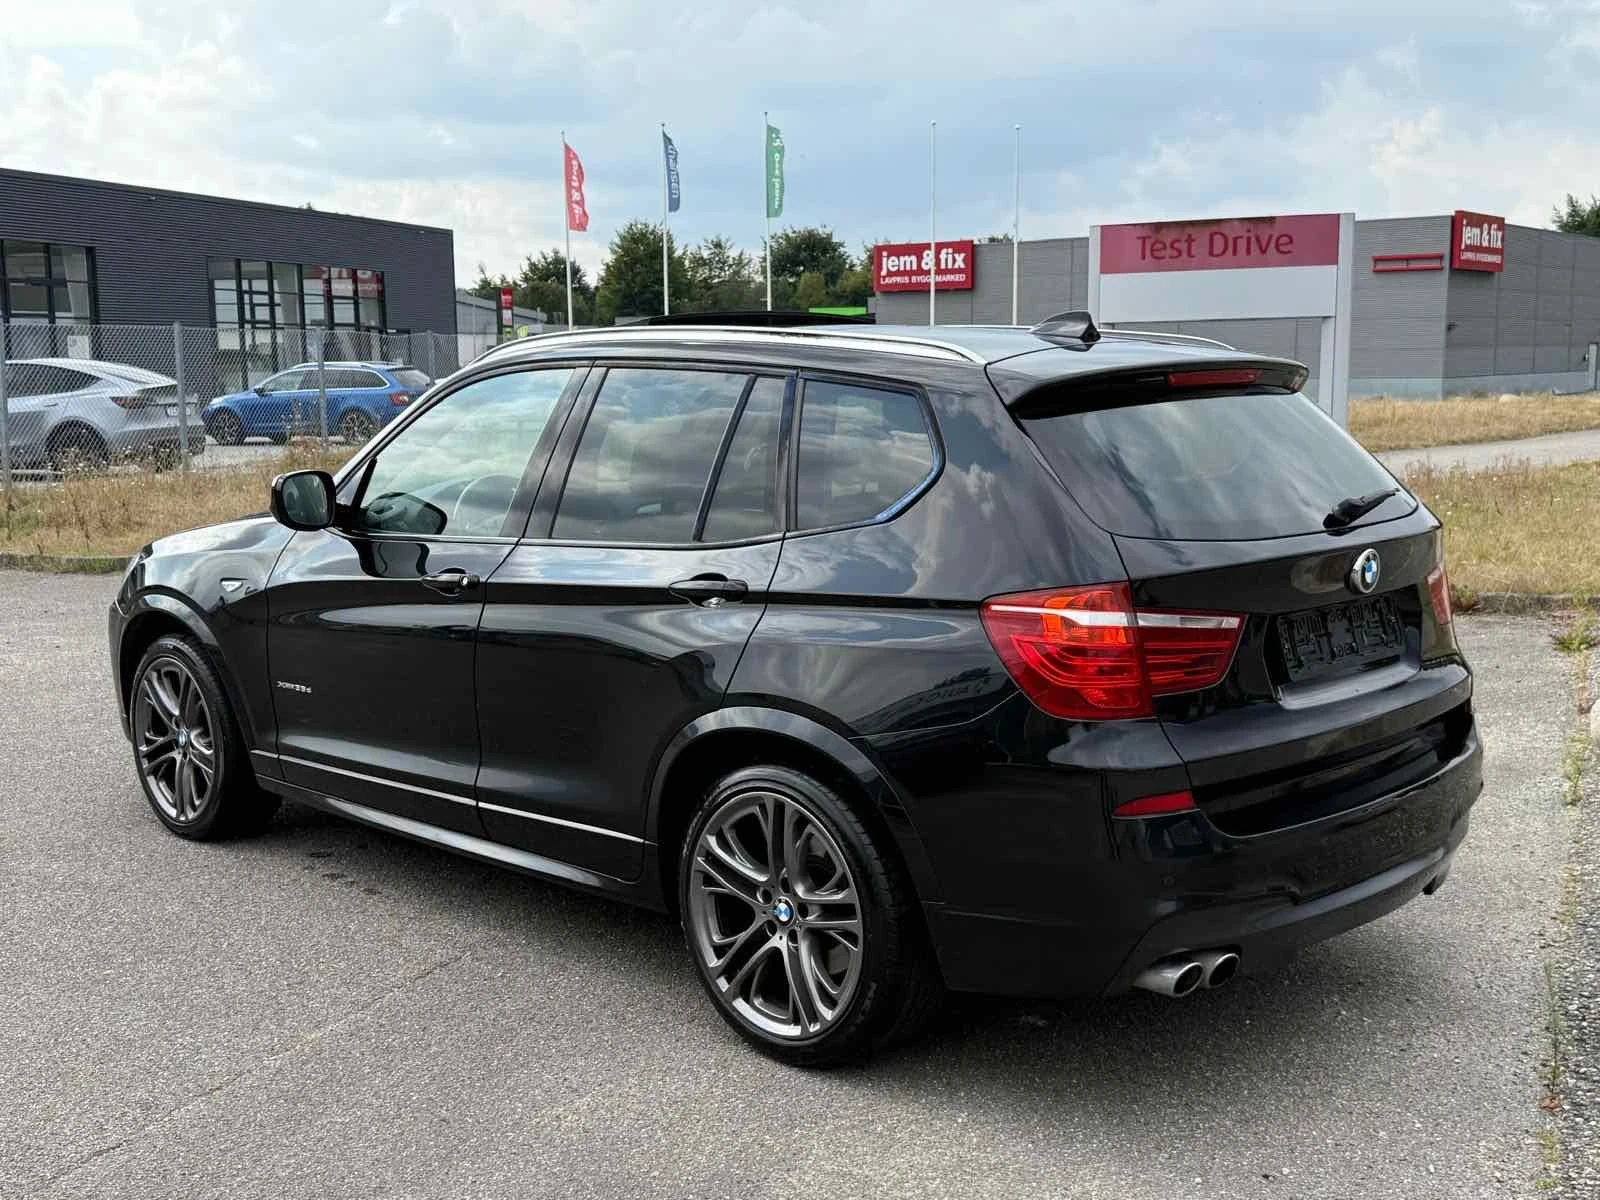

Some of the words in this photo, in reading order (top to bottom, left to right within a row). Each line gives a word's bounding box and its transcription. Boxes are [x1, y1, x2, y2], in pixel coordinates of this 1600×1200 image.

[1136, 233, 1196, 261] Test
[1208, 229, 1294, 258] Drive
[1461, 219, 1480, 249] jem
[1481, 223, 1490, 248] &
[1490, 224, 1503, 249] fix
[880, 251, 918, 276] jem
[921, 249, 937, 270] &
[939, 247, 967, 269] fix
